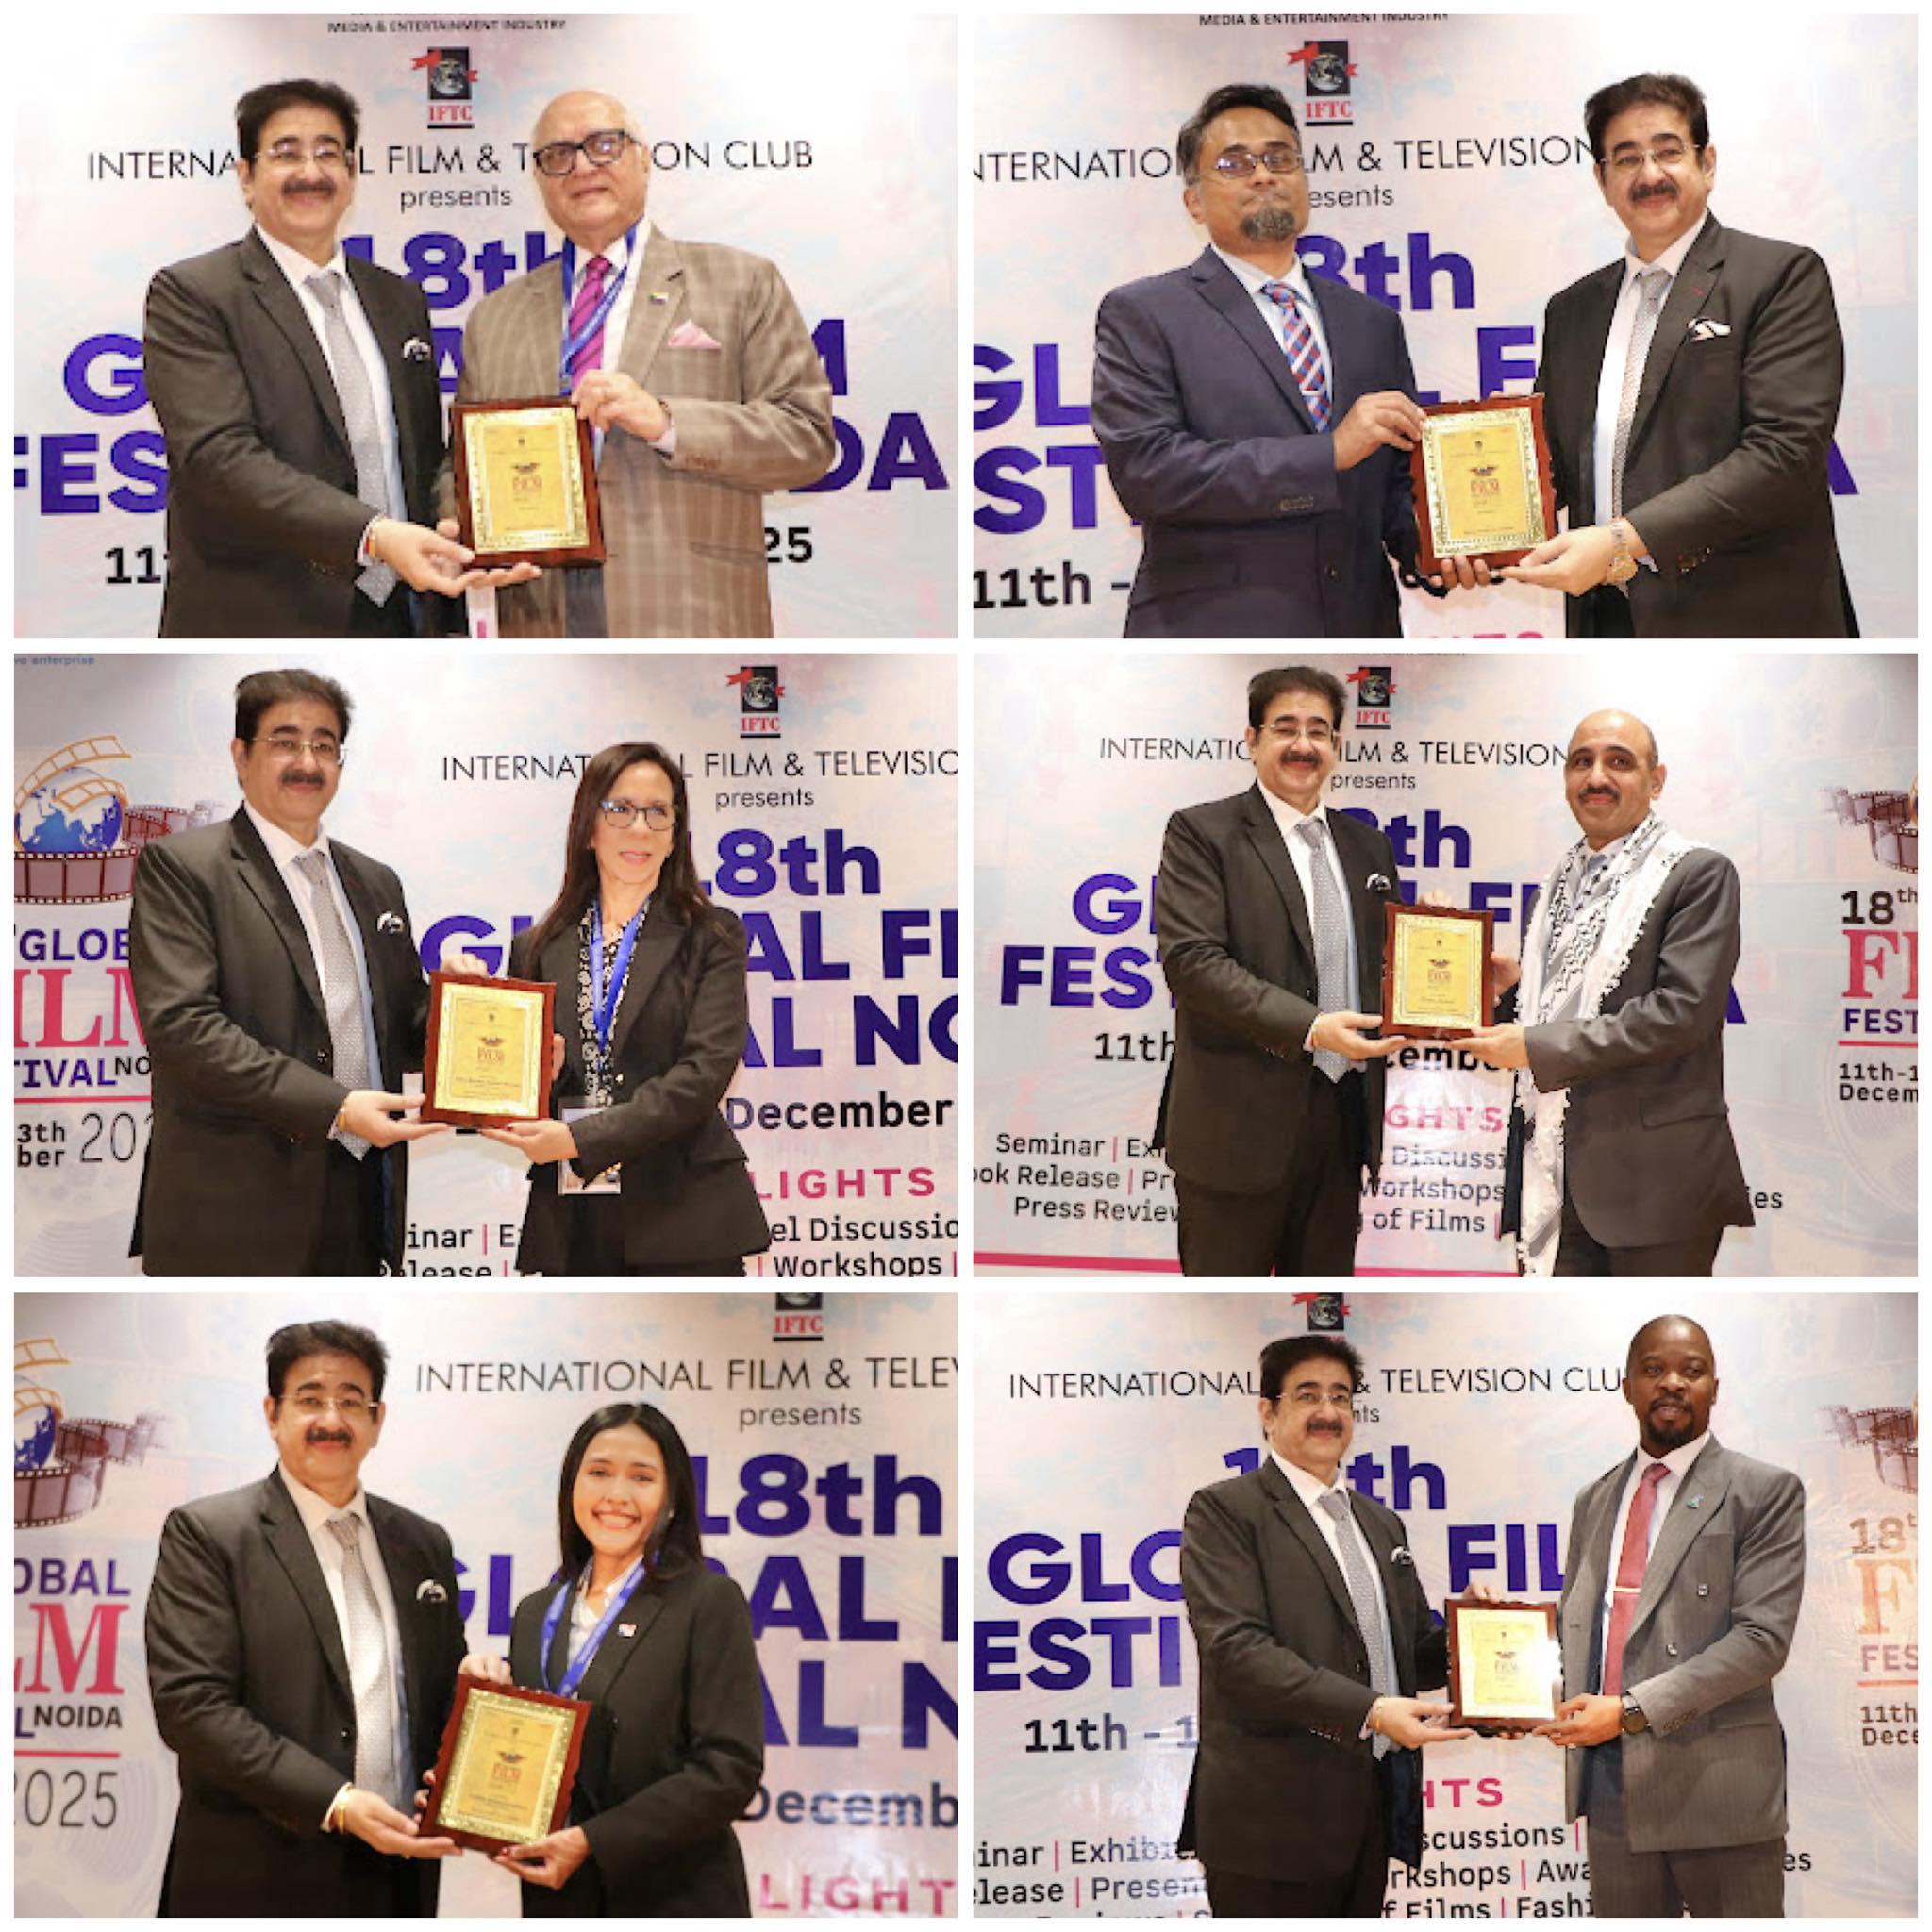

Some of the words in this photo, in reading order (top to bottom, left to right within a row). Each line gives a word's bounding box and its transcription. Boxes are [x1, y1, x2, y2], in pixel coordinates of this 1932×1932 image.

[327, 23, 373, 33] MEDIA
[377, 22, 387, 32] &
[390, 20, 499, 33] ENTERTAINMENT
[502, 20, 566, 30] INDUSTRY
[1199, 14, 1246, 25] MEDIA
[1265, 14, 1377, 25] ENTERTAINMENT
[429, 105, 473, 121] IFTC
[1306, 101, 1353, 117] IFTC
[388, 146, 464, 174] FILM
[476, 143, 502, 173] &
[724, 140, 813, 170] CLUB
[1357, 142, 1381, 171] &
[401, 186, 512, 213] presents
[1309, 185, 1394, 208] esents
[741, 717, 780, 732] IFTC
[1357, 711, 1391, 724] IFTC
[706, 753, 772, 778] FILM
[784, 752, 804, 777] &
[815, 750, 958, 777] TELEVISIO
[1391, 741, 1409, 763] &
[1330, 773, 1416, 791] presents
[715, 787, 814, 812] presents
[689, 828, 881, 897] 8th
[726, 1091, 954, 1130] December
[996, 1132, 1106, 1156] Seminar
[1392, 1144, 1507, 1169] Discussi
[1018, 1164, 1120, 1189] Release
[1014, 1196, 1085, 1219] Press
[1373, 1208, 1402, 1231] of
[1410, 1208, 1485, 1232] Films
[408, 1223, 474, 1248] inar
[810, 1212, 958, 1241] Discussio
[774, 1251, 942, 1277] Workshops
[774, 1316, 823, 1334] IFTC
[416, 1360, 712, 1392] INTERNATIONAL
[727, 1359, 810, 1391] FILM
[824, 1358, 851, 1390] &
[1010, 1371, 1260, 1398] INTERNATIONAL
[1381, 1367, 1551, 1393] TELEVISION
[1563, 1367, 1622, 1392] CLU
[739, 1403, 861, 1432] presents
[34, 1705, 122, 1728] NOIDA
[1025, 1712, 1128, 1753] 11th
[14, 1770, 118, 1828] 025
[741, 1782, 958, 1827] Decemb
[978, 1840, 1044, 1867] inar
[1422, 1823, 1565, 1850] scussions
